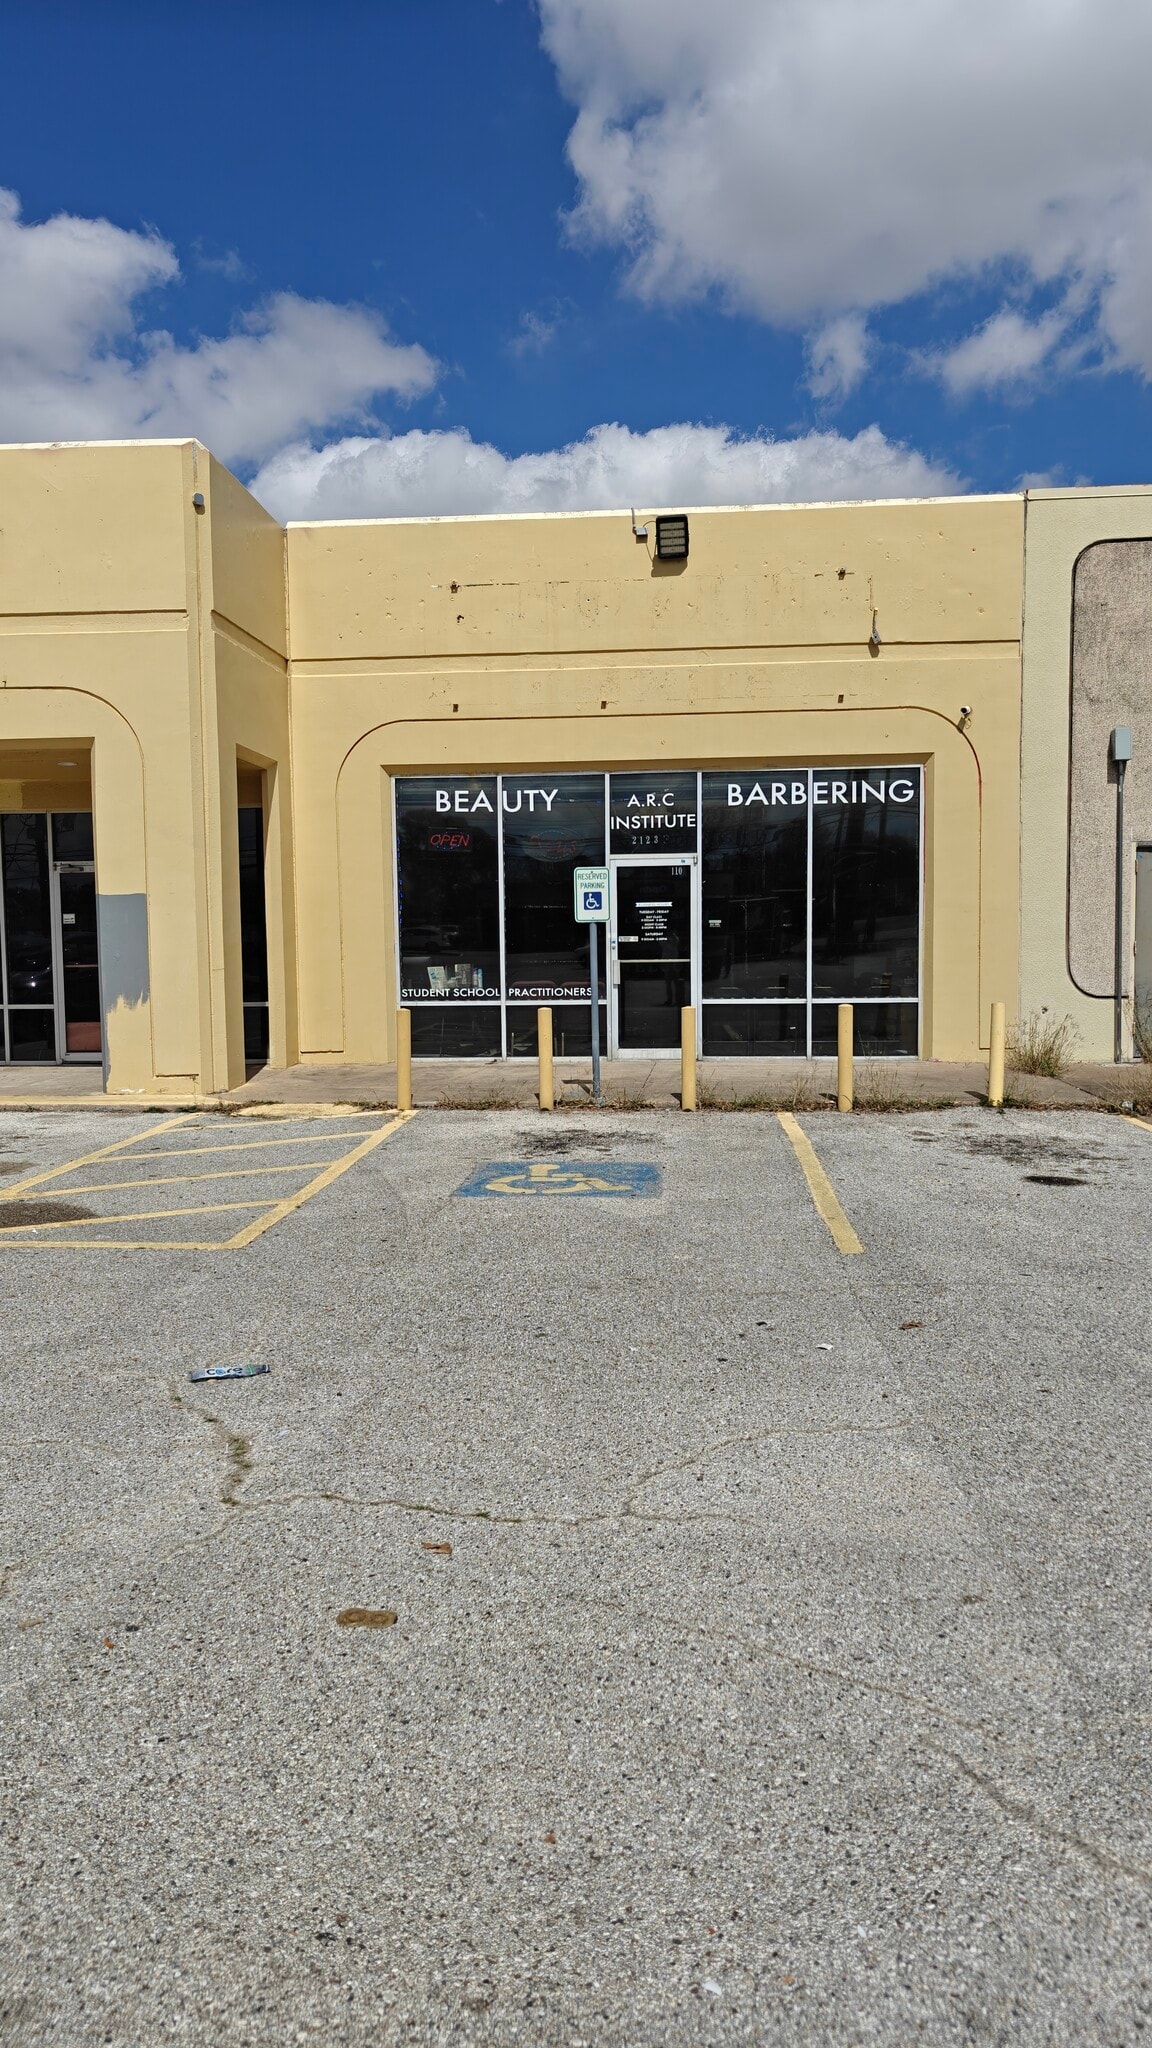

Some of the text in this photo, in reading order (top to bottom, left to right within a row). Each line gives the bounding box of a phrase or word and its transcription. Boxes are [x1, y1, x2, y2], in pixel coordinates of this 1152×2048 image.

[727, 779, 915, 807] BARBERING
[435, 788, 559, 813] BEAUTY
[627, 793, 675, 808] A.R.C
[610, 814, 696, 830] INSTITUTE
[430, 833, 471, 847] OPEN
[577, 873, 608, 881] RESERVED
[671, 866, 683, 876] 110
[401, 987, 500, 998] STUDENT SCHOOL
[509, 987, 592, 997] PRACTITIONERS
